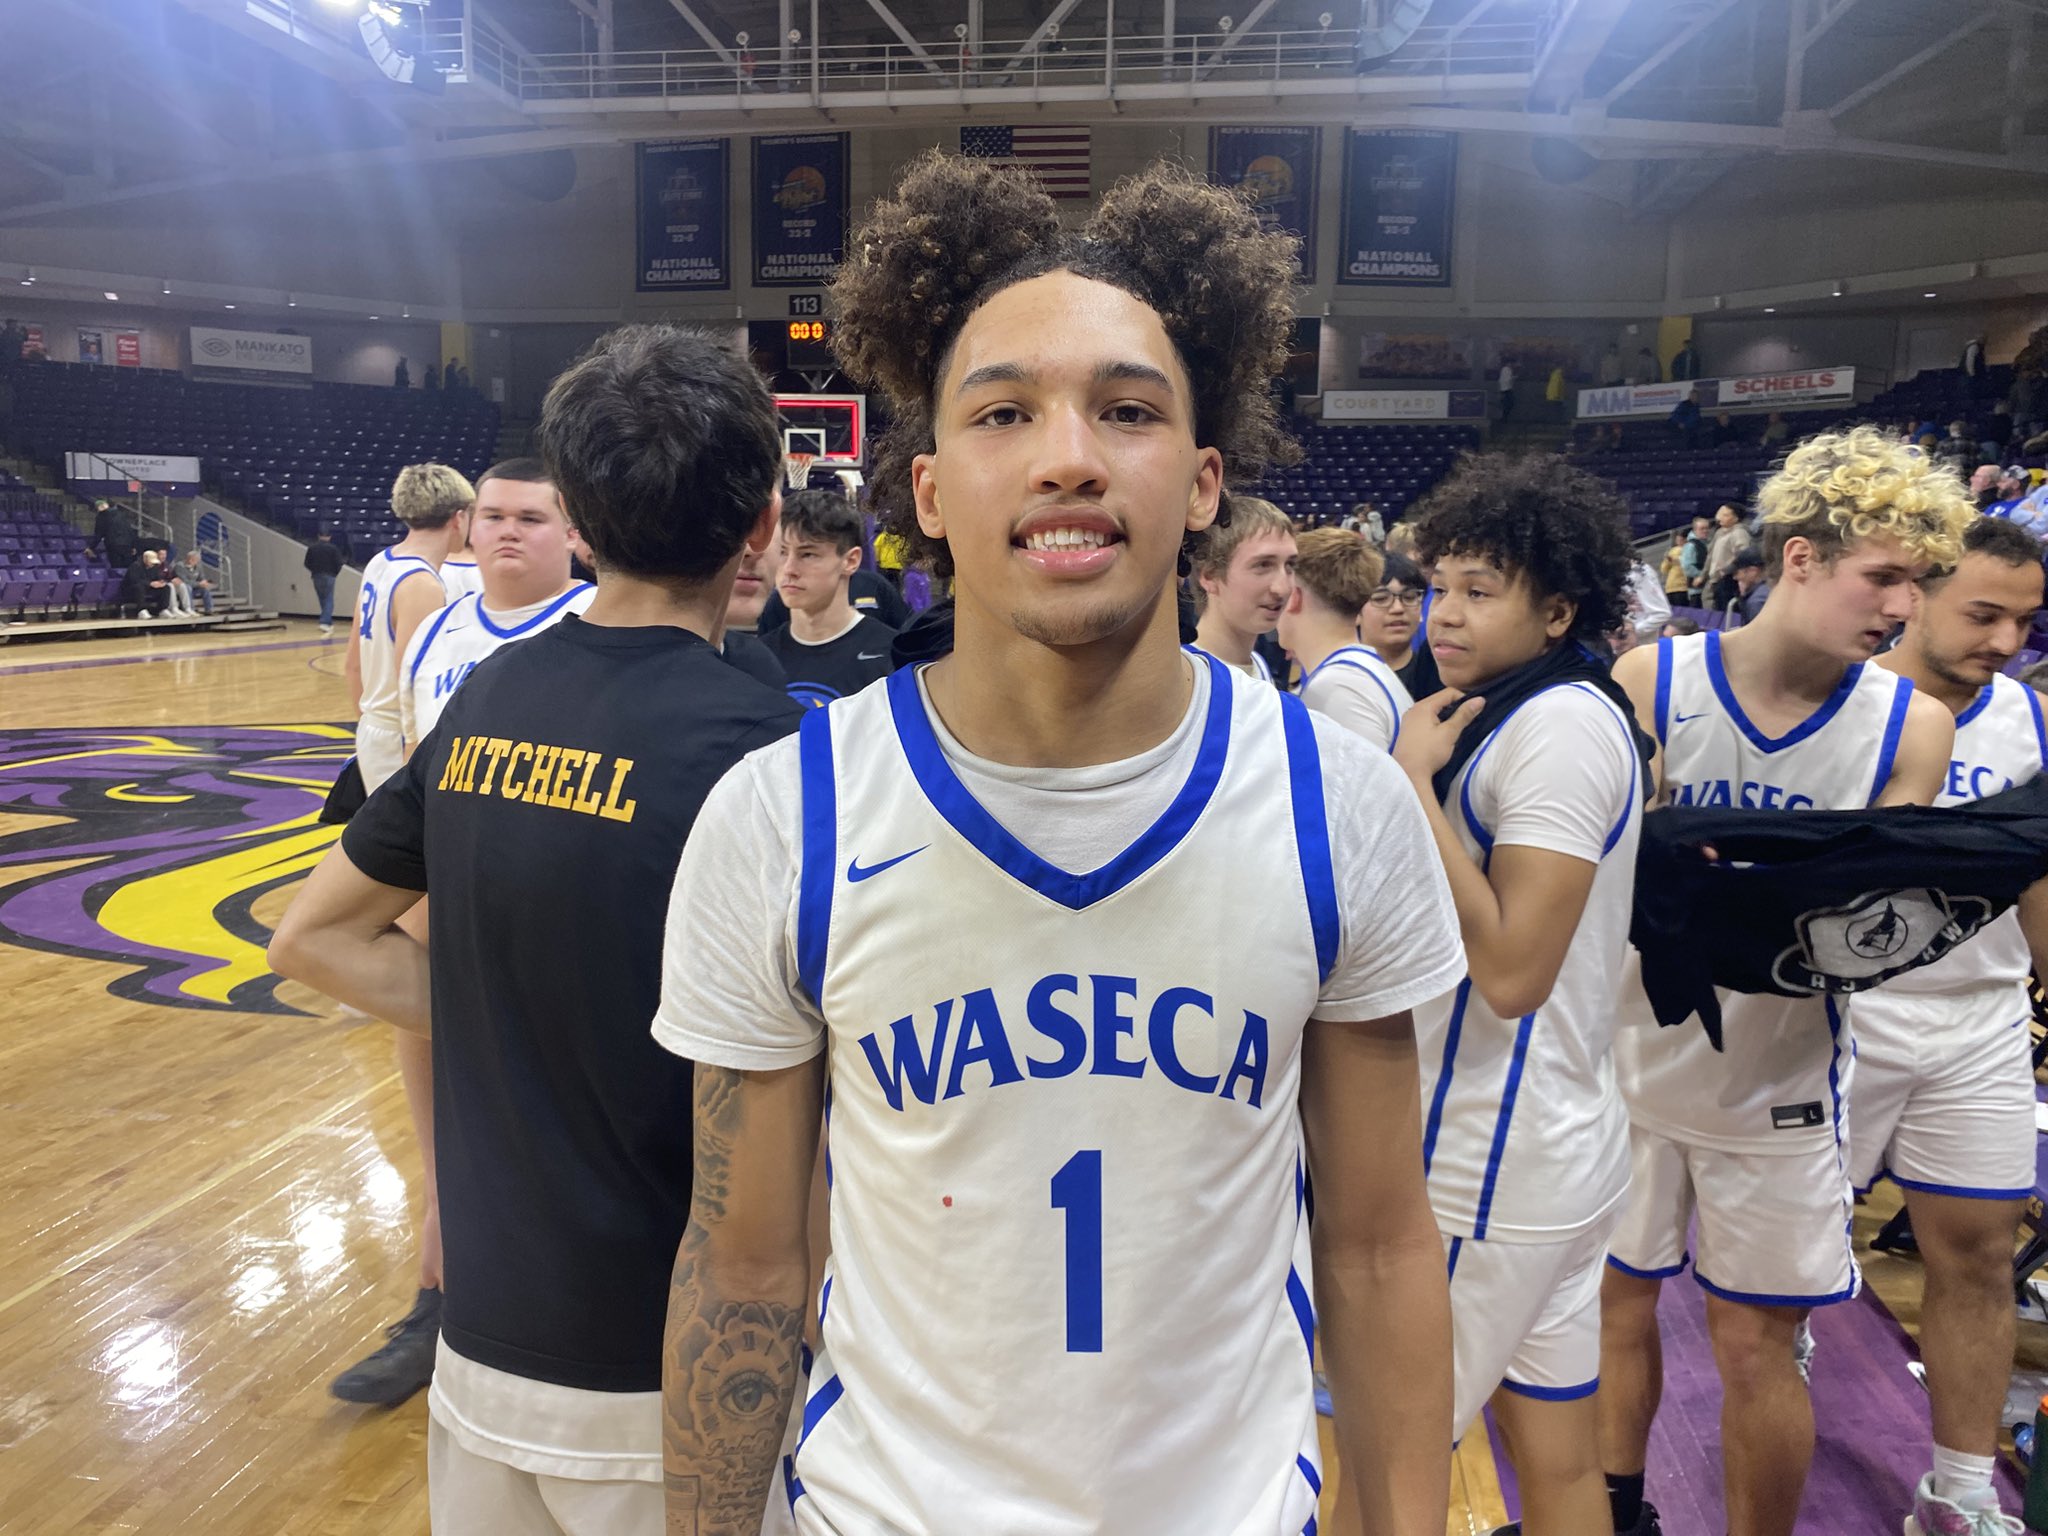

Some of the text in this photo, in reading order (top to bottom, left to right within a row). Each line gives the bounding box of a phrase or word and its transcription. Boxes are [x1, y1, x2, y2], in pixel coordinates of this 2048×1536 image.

[651, 257, 714, 269] NATIONAL
[767, 253, 835, 265] NATIONAL
[1357, 250, 1432, 263] NATIONAL
[645, 268, 720, 282] CHAMPIONS
[1349, 261, 1440, 277] CHAMPIONS
[792, 297, 818, 313] 113
[235, 339, 305, 356] MANKATO
[1733, 372, 1836, 395] SCHEELS
[1333, 397, 1436, 409] COURTYARD
[437, 735, 637, 823] MITCHELL
[857, 973, 1269, 1113] WASECA
[1050, 1149, 1103, 1353] 1
